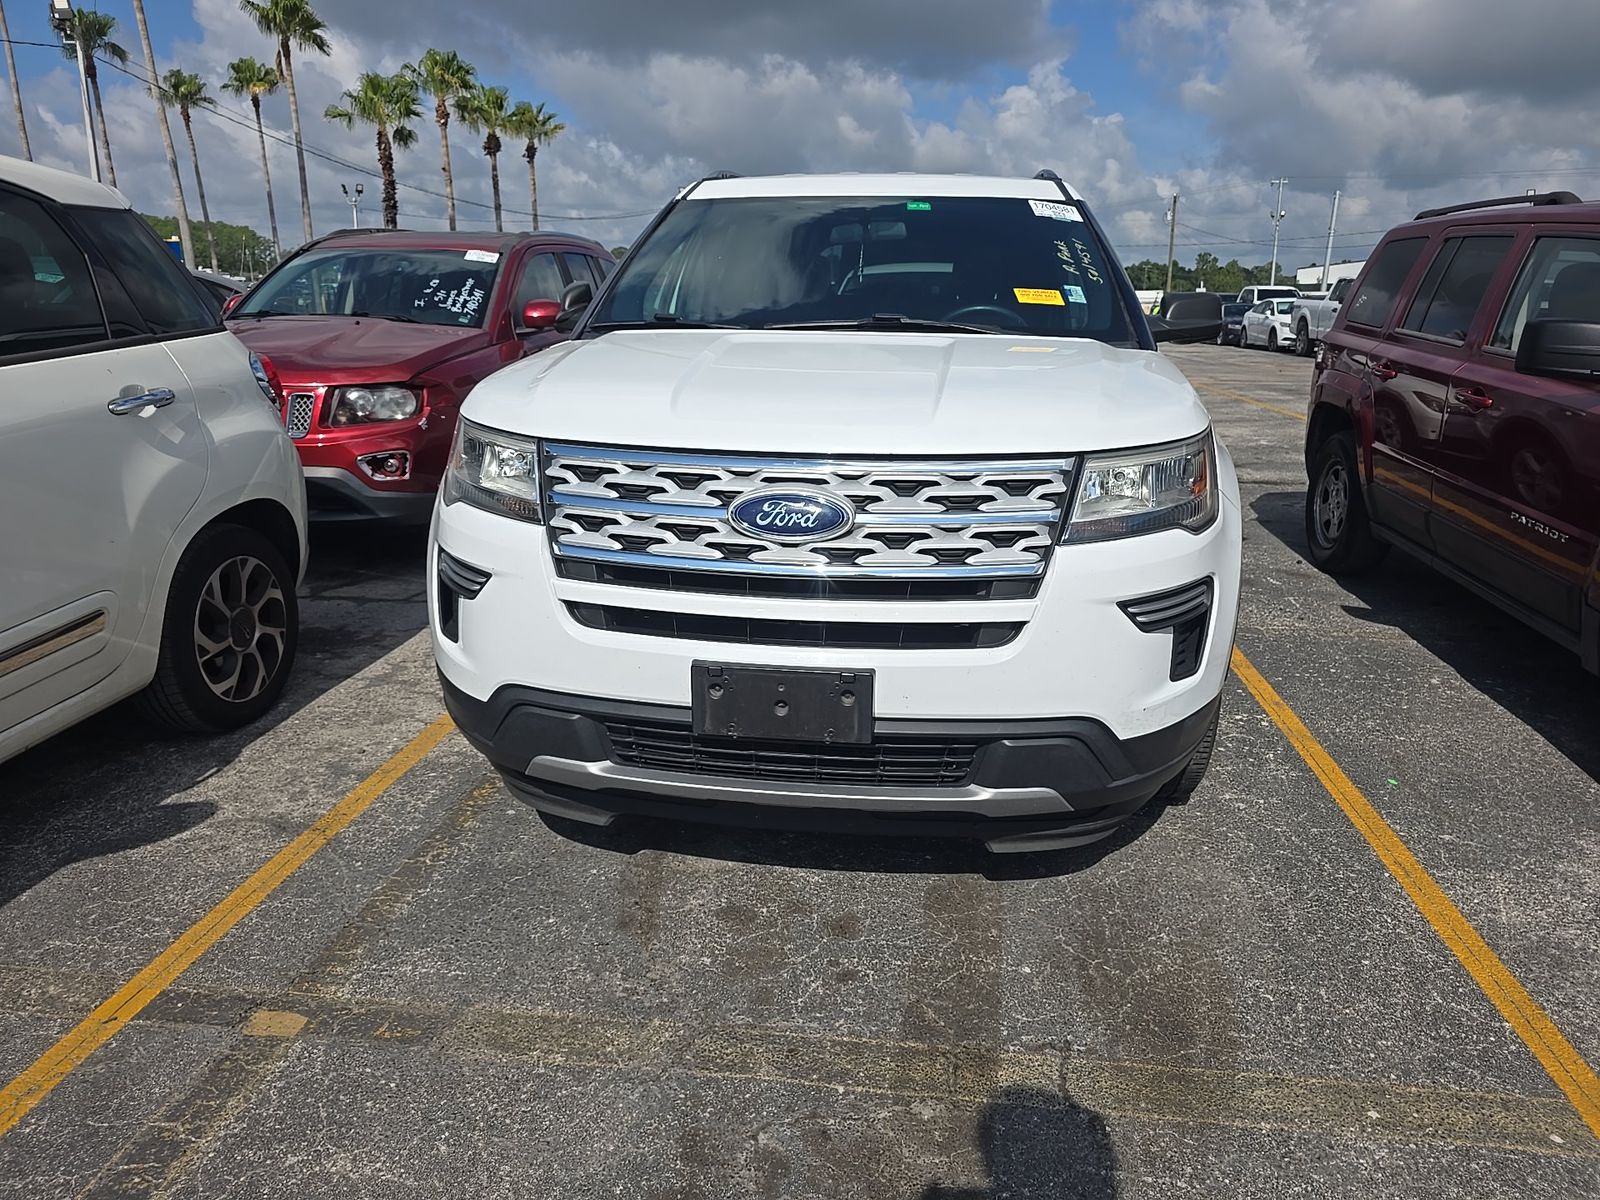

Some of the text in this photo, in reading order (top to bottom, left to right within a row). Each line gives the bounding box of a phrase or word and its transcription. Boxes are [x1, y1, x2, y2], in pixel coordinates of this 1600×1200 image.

[1033, 202, 1075, 214] 1704581
[756, 500, 821, 527] Ford
[1510, 511, 1569, 543] PATRIOT
